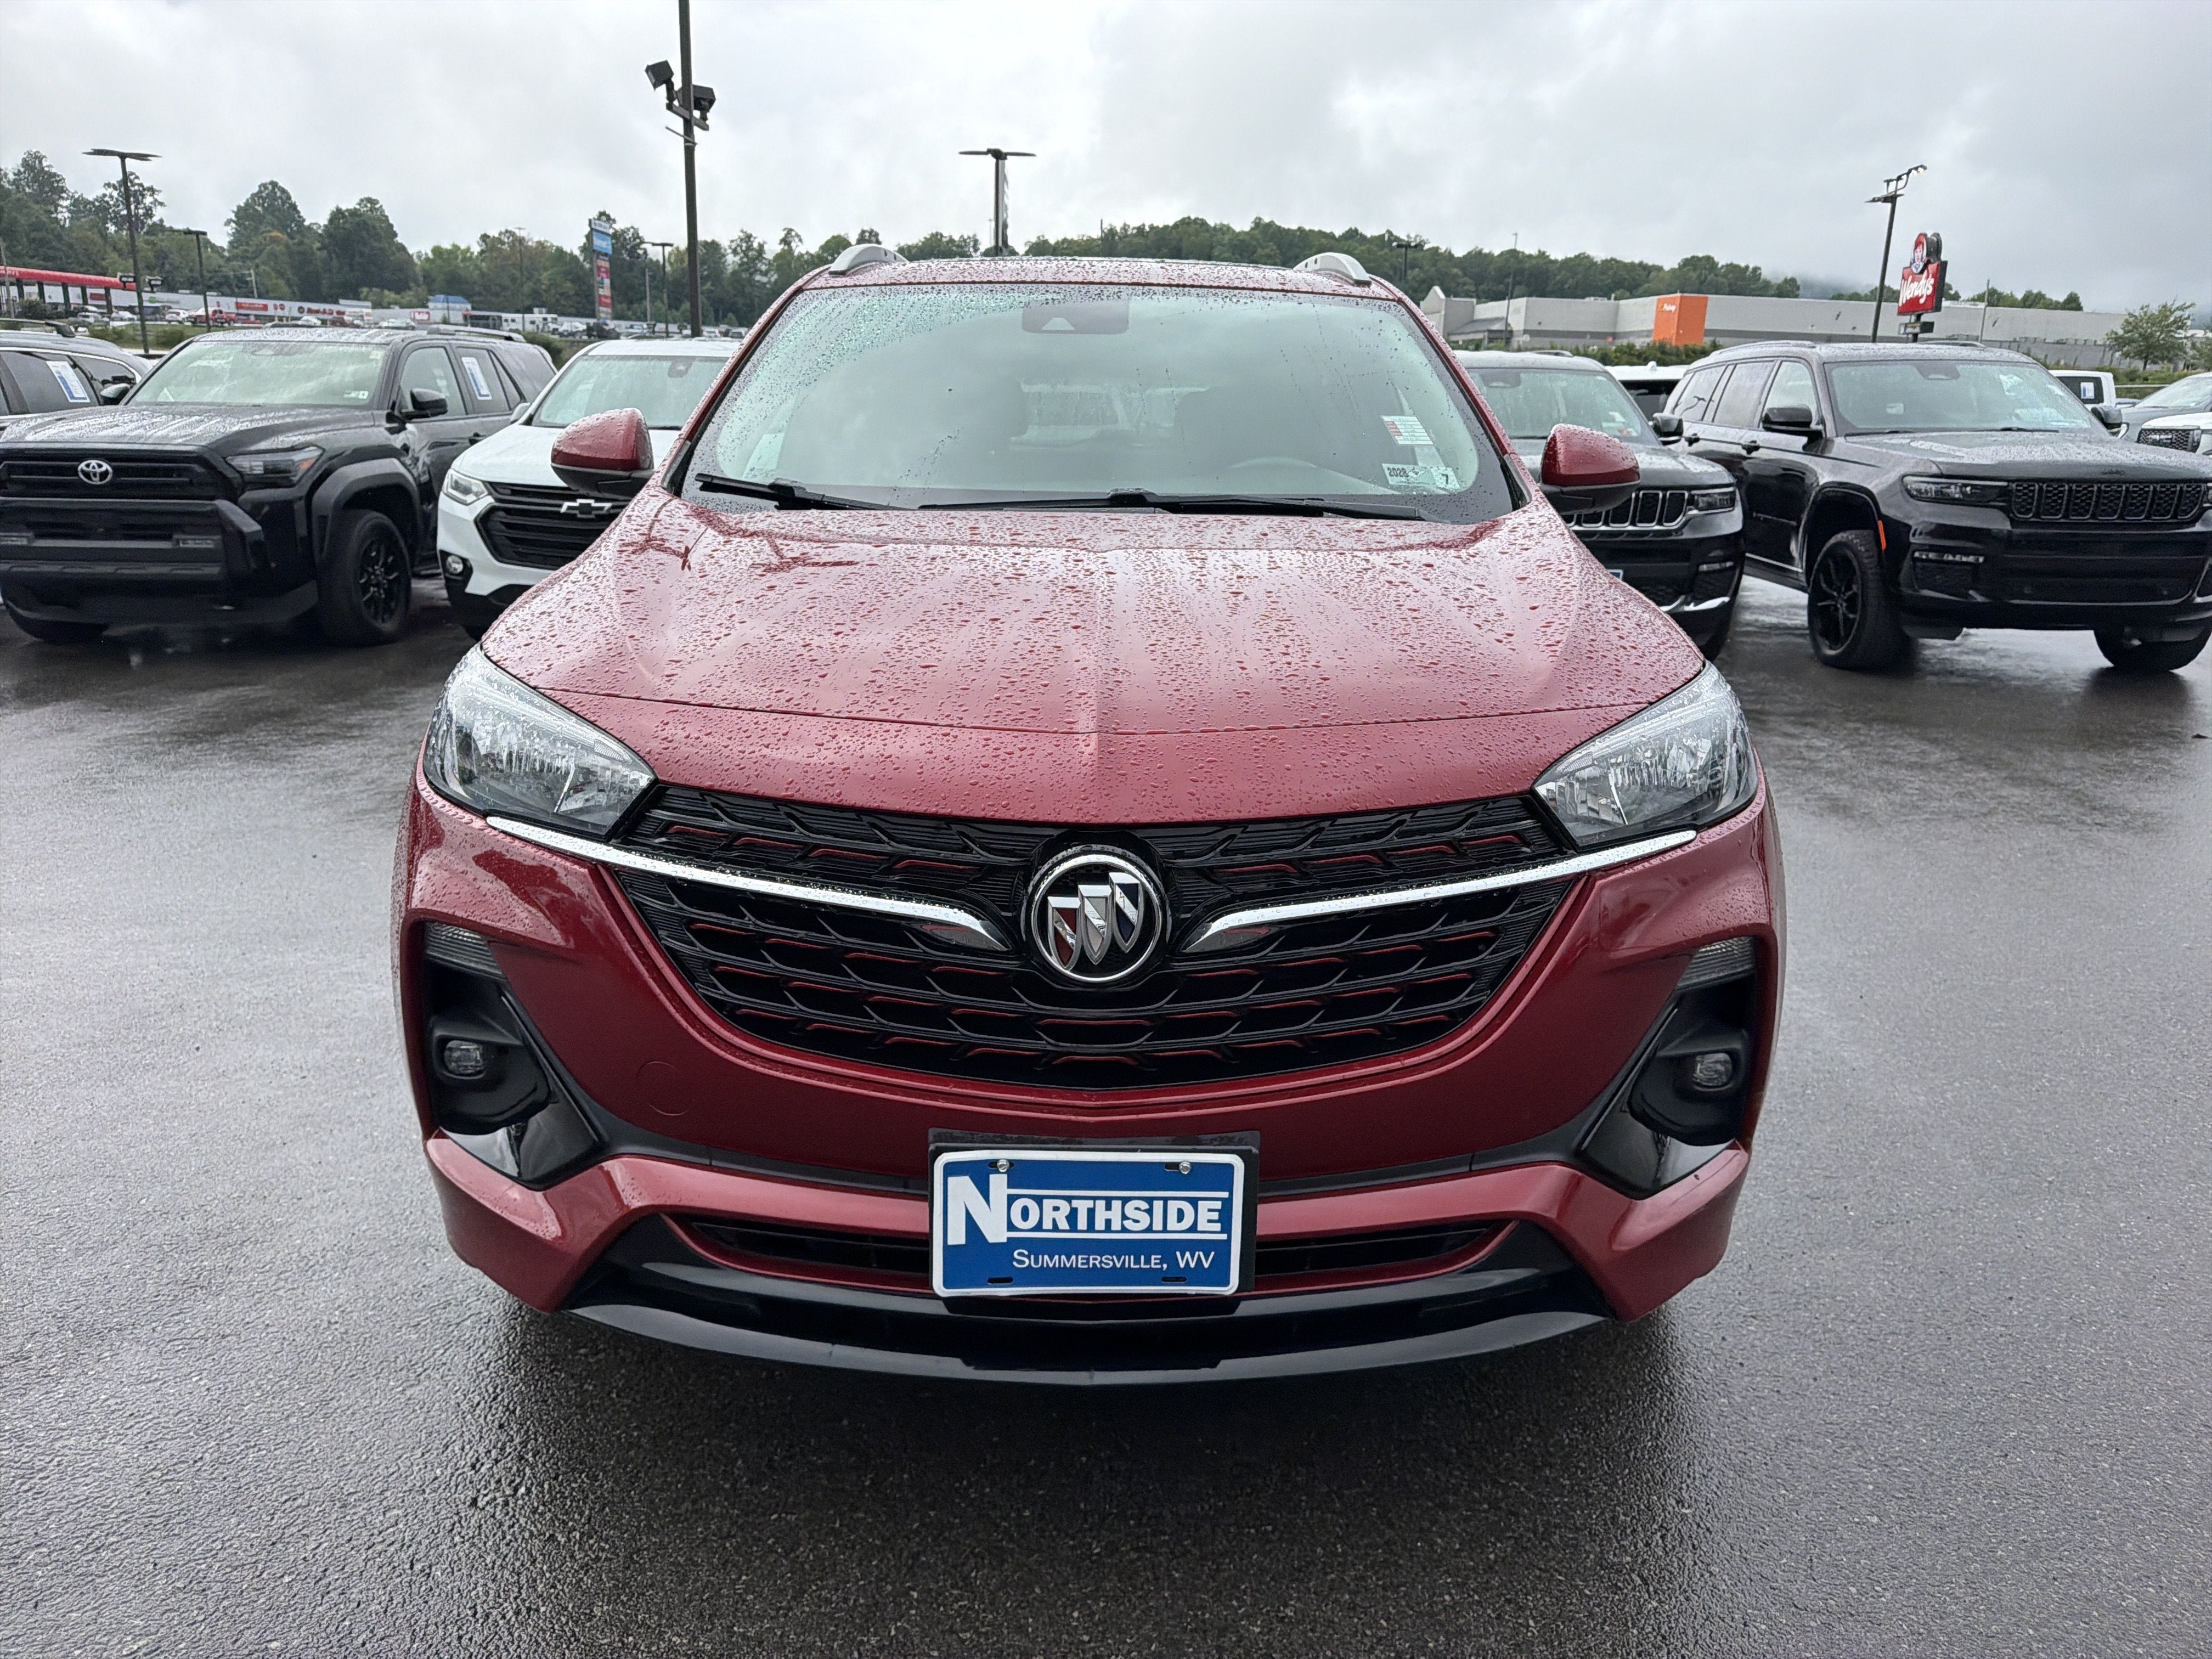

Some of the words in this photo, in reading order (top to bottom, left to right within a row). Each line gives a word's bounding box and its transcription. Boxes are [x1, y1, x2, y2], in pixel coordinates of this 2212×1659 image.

[1899, 269, 1935, 307] Wendy's
[1387, 467, 1409, 478] 2028
[947, 1173, 1222, 1246] NORTHSIDE
[1013, 1249, 1167, 1271] SUMMERSVILLE,
[1176, 1251, 1215, 1269] WV
